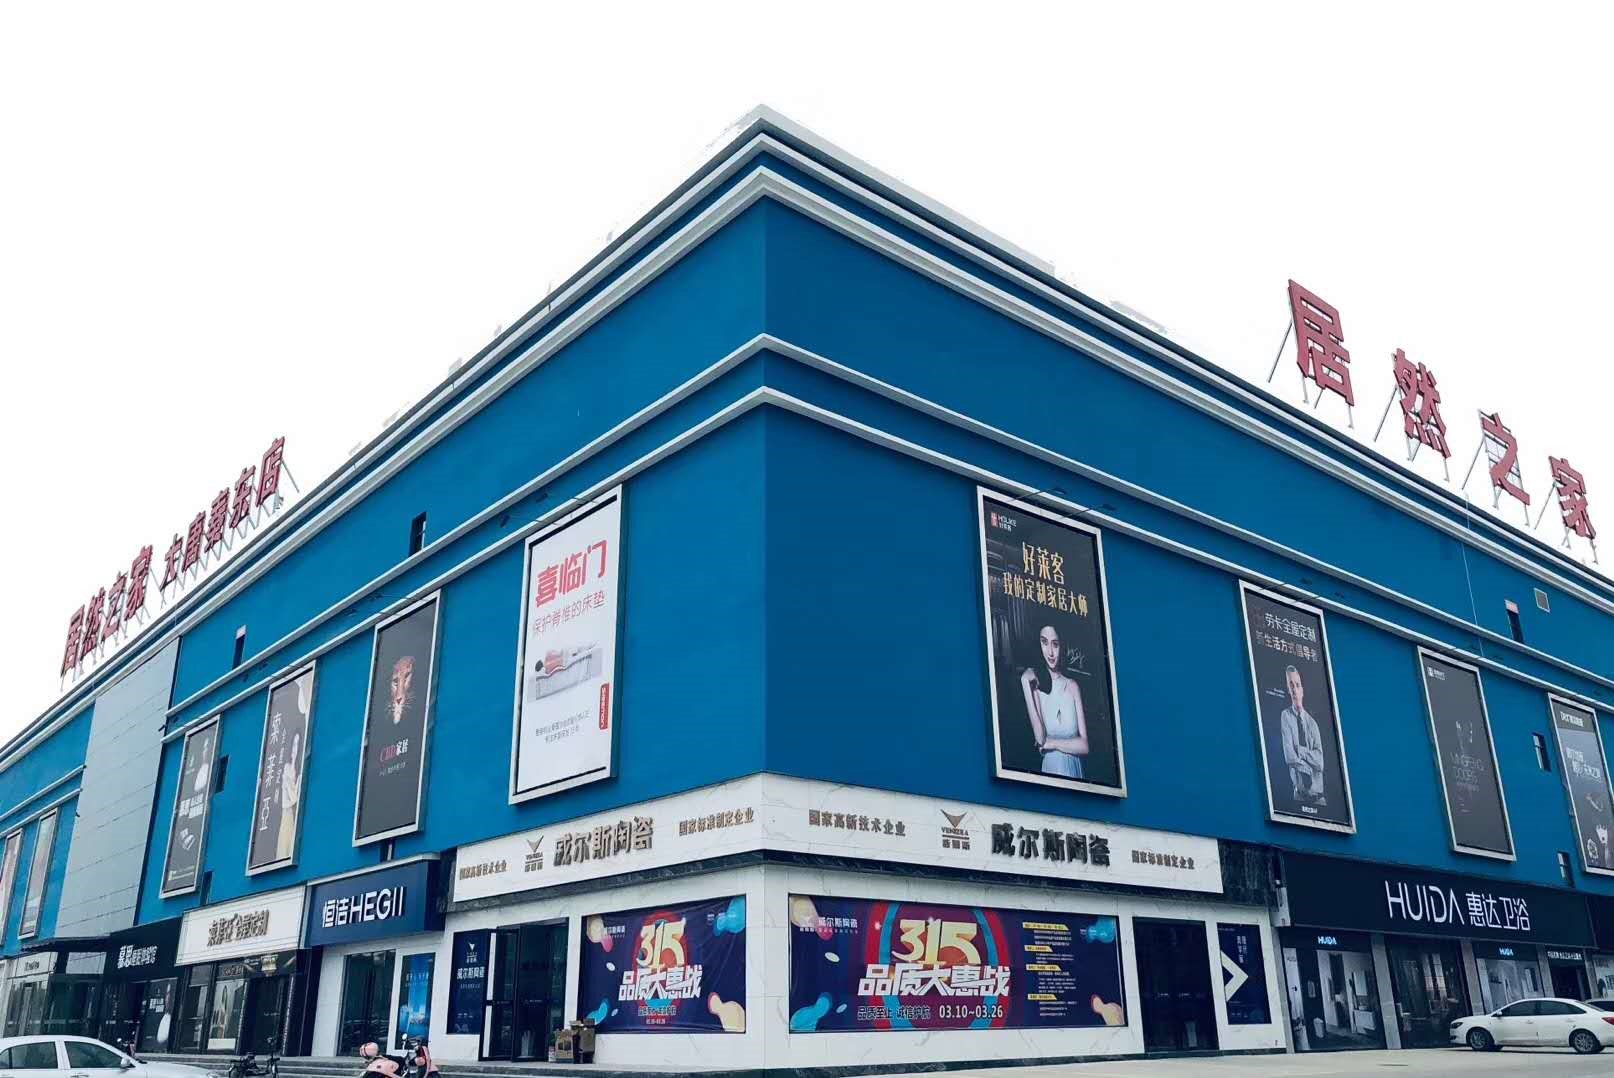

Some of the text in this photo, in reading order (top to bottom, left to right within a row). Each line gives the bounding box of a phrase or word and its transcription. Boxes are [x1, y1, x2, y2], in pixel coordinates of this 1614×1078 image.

[1287, 278, 1596, 540] 居然之家
[535, 539, 608, 608] 喜临门
[1022, 541, 1065, 585] 好莱客
[1003, 571, 1089, 617] 我的定制家居大师
[1264, 612, 1317, 643] 劳卡全屋定制
[552, 815, 653, 868] 威尔斯陶瓷
[679, 806, 754, 837] 国家标准制定企业
[808, 808, 906, 837] 国家高新技术企业
[990, 822, 1111, 868] 威尔斯陶瓷
[1131, 849, 1195, 870] 国家标准制定企业
[1385, 880, 1531, 931] HUIDA 惠达卫浴
[636, 917, 687, 969] 315
[890, 917, 981, 967] 315
[1317, 935, 1337, 945] HUIDA
[618, 964, 703, 1002] 品质大惠战
[857, 962, 1012, 997] 品质大惠战
